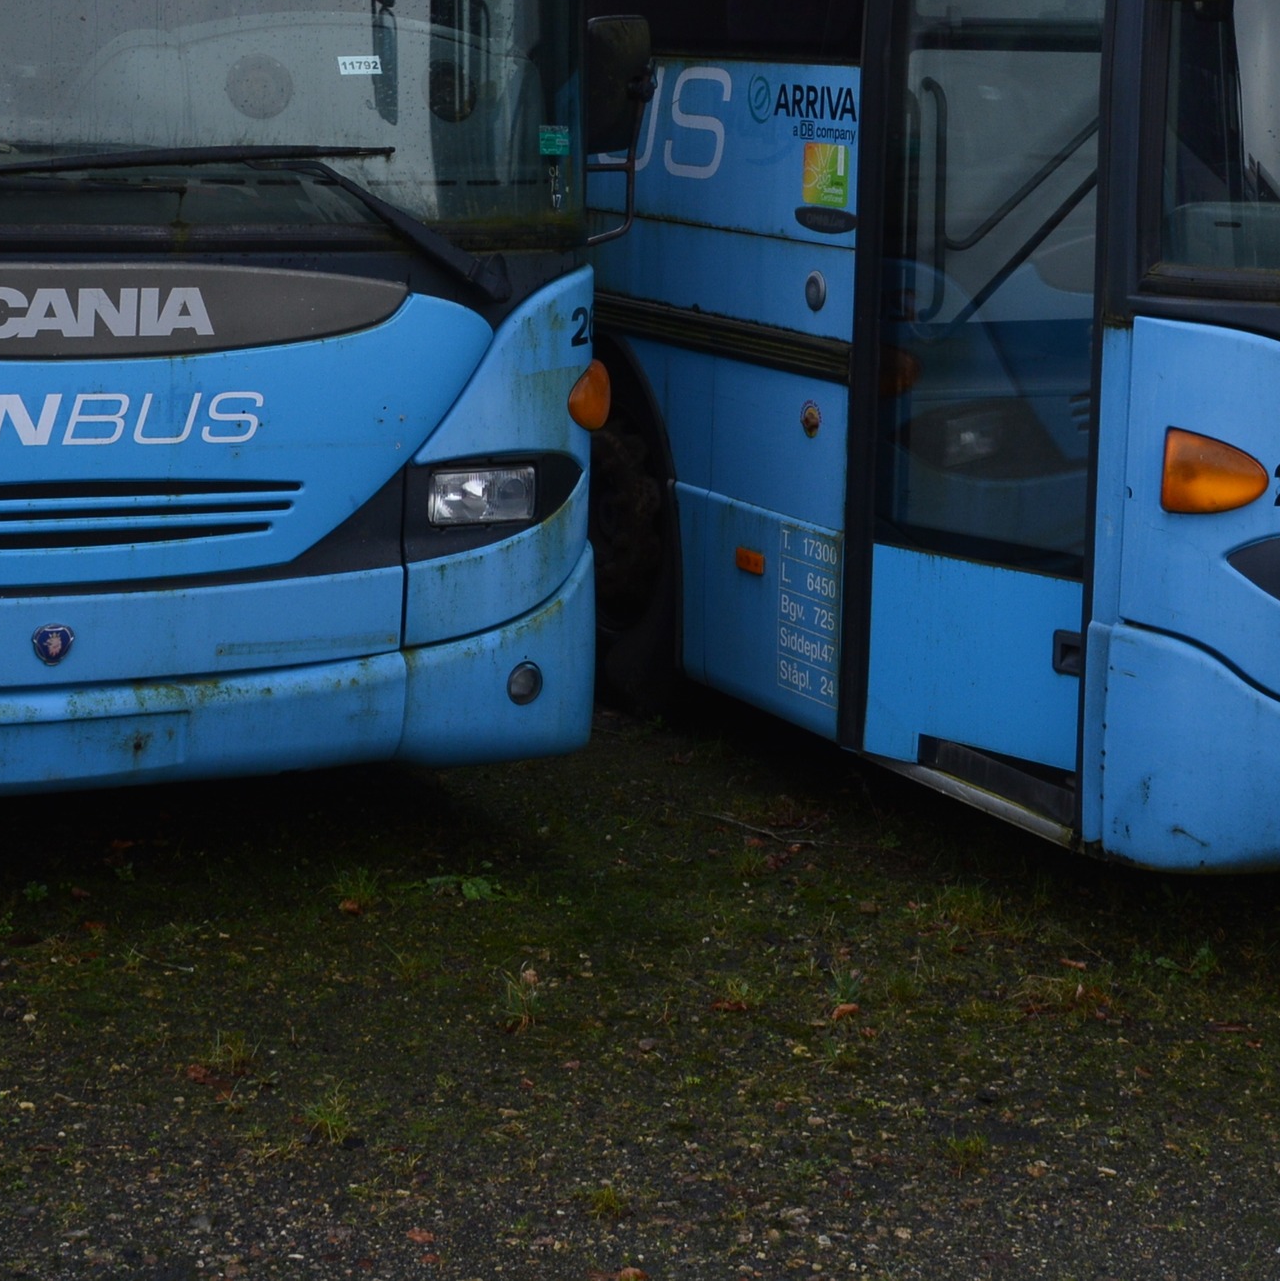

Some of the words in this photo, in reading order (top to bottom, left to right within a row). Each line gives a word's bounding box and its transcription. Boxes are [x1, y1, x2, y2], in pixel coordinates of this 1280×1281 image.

[341, 61, 379, 70] 11792
[773, 83, 857, 122] ARRIVA
[793, 124, 798, 137] a
[800, 121, 814, 139] DB
[816, 126, 856, 144] company
[782, 530, 791, 550] T.
[803, 538, 837, 565] 17300
[782, 562, 791, 583] L.
[807, 573, 836, 599] 6450
[781, 595, 805, 620] Bgv.
[813, 607, 835, 631] 725
[780, 660, 812, 690] Ståpl.
[821, 676, 834, 697] 24
